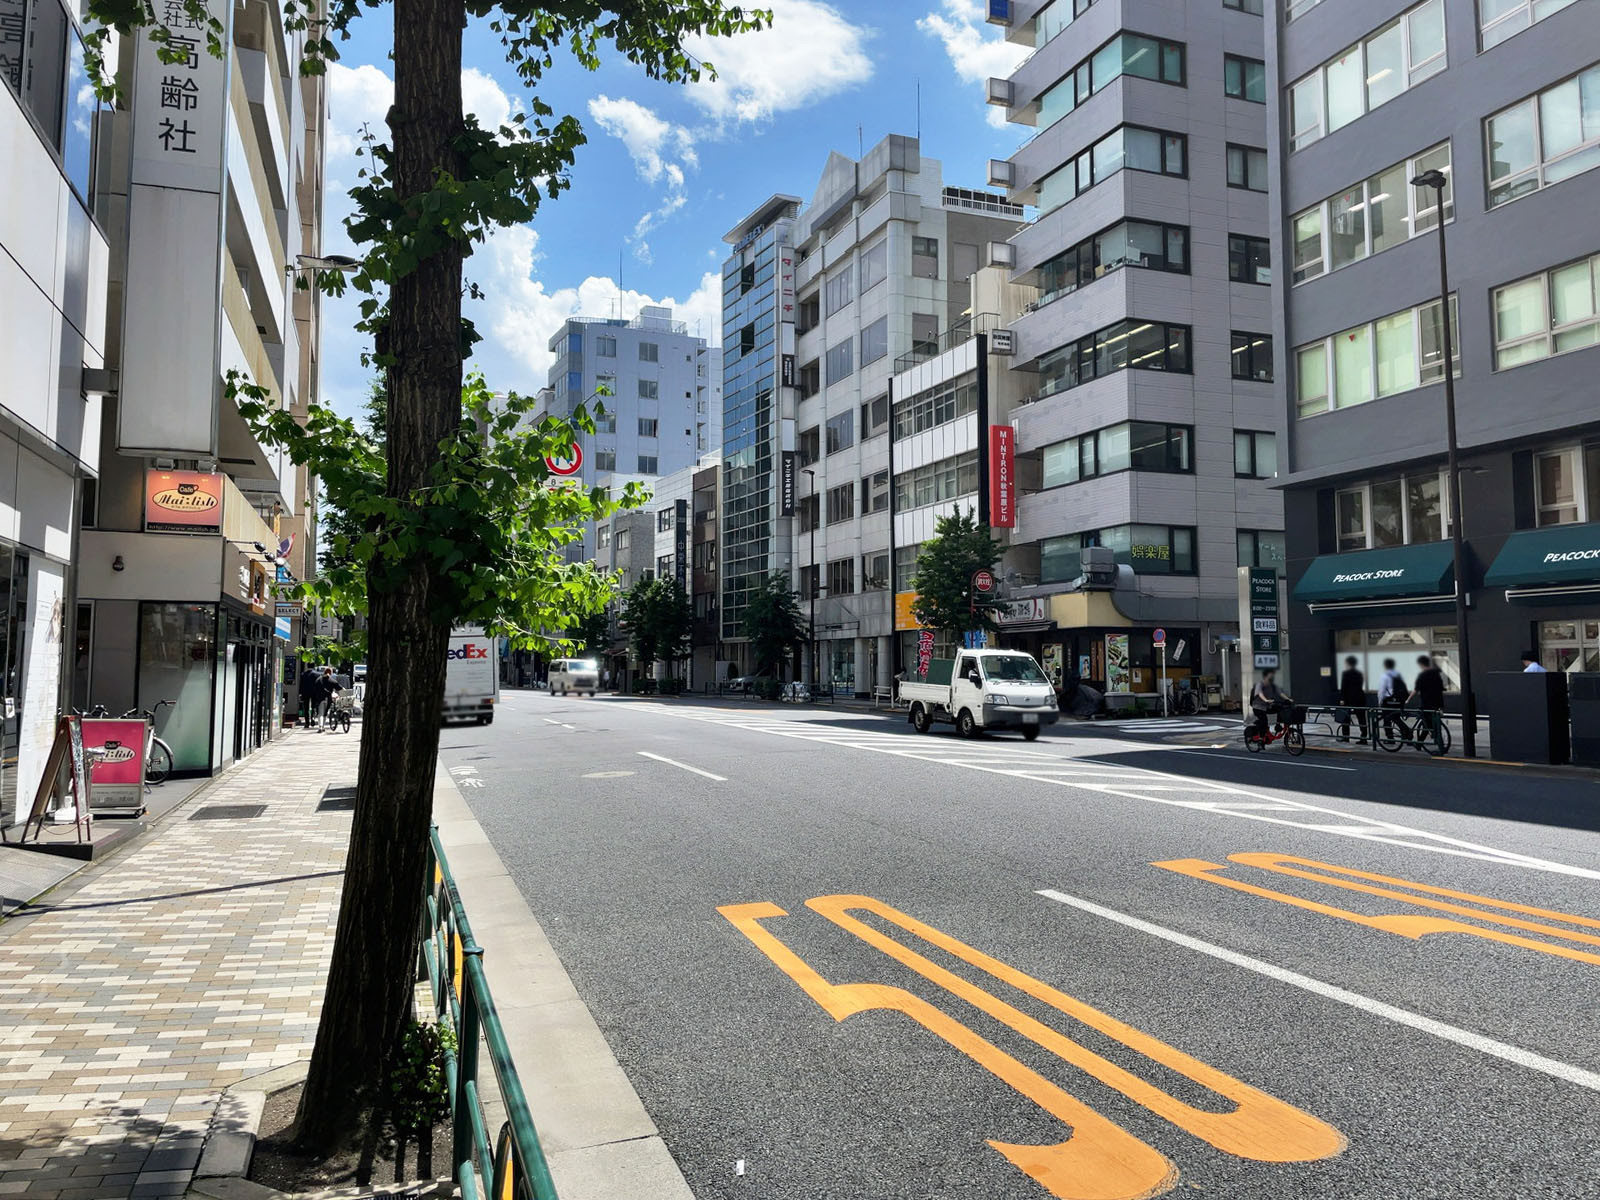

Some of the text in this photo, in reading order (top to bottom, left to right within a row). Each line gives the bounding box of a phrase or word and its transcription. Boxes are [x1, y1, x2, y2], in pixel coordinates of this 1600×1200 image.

[1131, 544, 1171, 561] 娯楽屋
[1544, 549, 1600, 563] PEACOCK
[1252, 577, 1275, 585] PEACOCK
[1332, 568, 1405, 583] PEACOCK STORE
[1255, 585, 1272, 593] STORE
[1255, 619, 1276, 630] 食料品
[447, 643, 488, 660] edEx
[1257, 657, 1277, 665] ATM
[716, 894, 1349, 1200] 50
